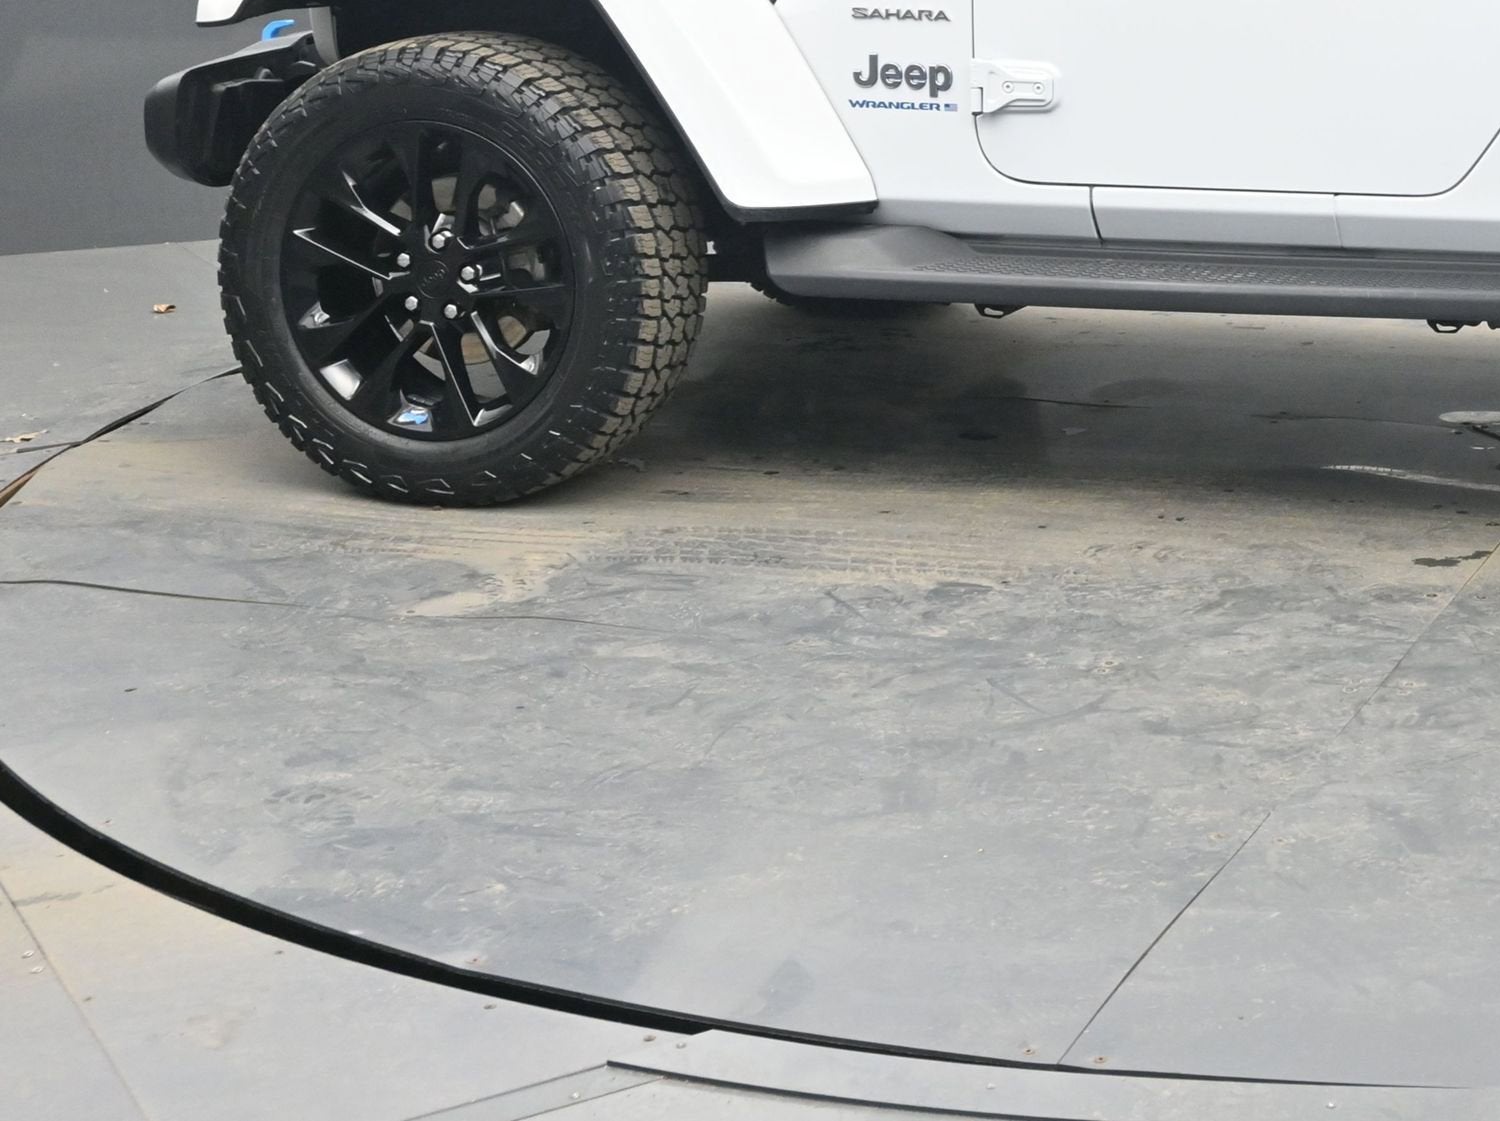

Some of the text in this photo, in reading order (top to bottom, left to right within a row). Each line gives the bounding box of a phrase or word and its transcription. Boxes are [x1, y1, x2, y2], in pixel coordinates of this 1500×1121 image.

[851, 7, 951, 22] SAHARA
[853, 53, 953, 98] Jeep
[848, 98, 941, 111] WRANGLER
